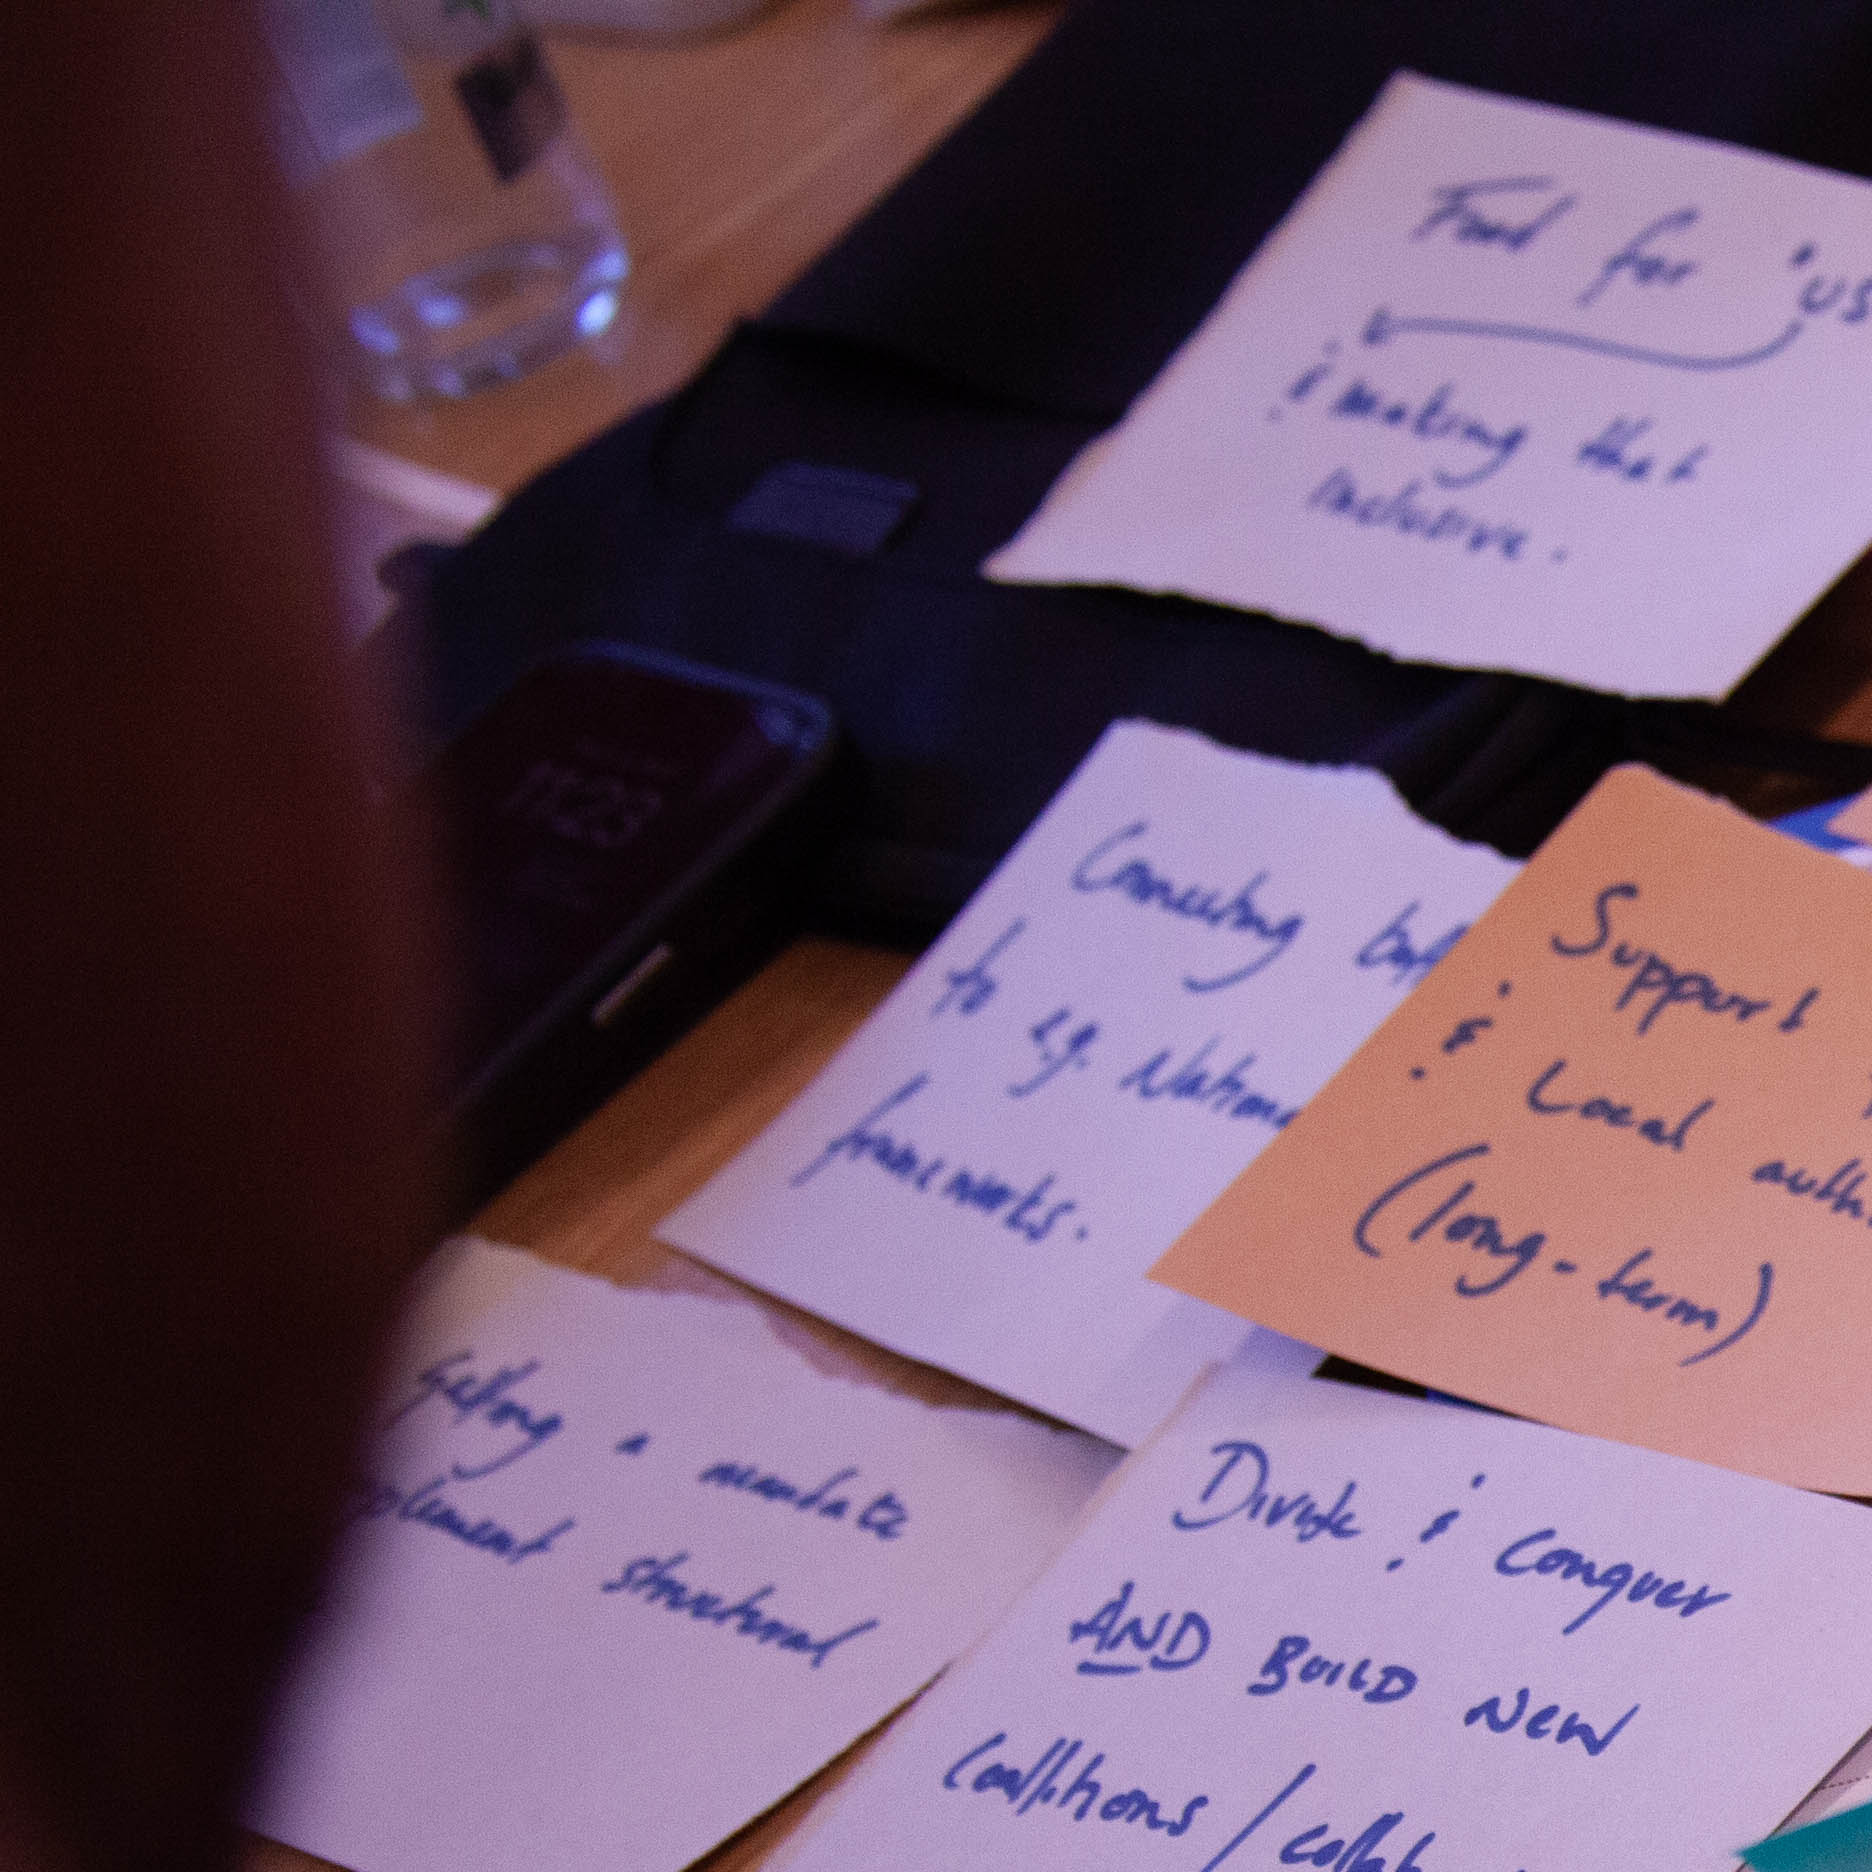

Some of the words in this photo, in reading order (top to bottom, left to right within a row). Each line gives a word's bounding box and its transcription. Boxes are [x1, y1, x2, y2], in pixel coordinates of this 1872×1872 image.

[1577, 208, 1699, 304] for
[1577, 416, 1710, 482] that
[931, 915, 1027, 1018] to
[1551, 883, 1821, 1035] Support
[697, 1464, 910, 1543] mandate
[1171, 1440, 1363, 1546] Divide
[601, 1551, 881, 1670] structural
[1069, 1580, 1212, 1677] AND
